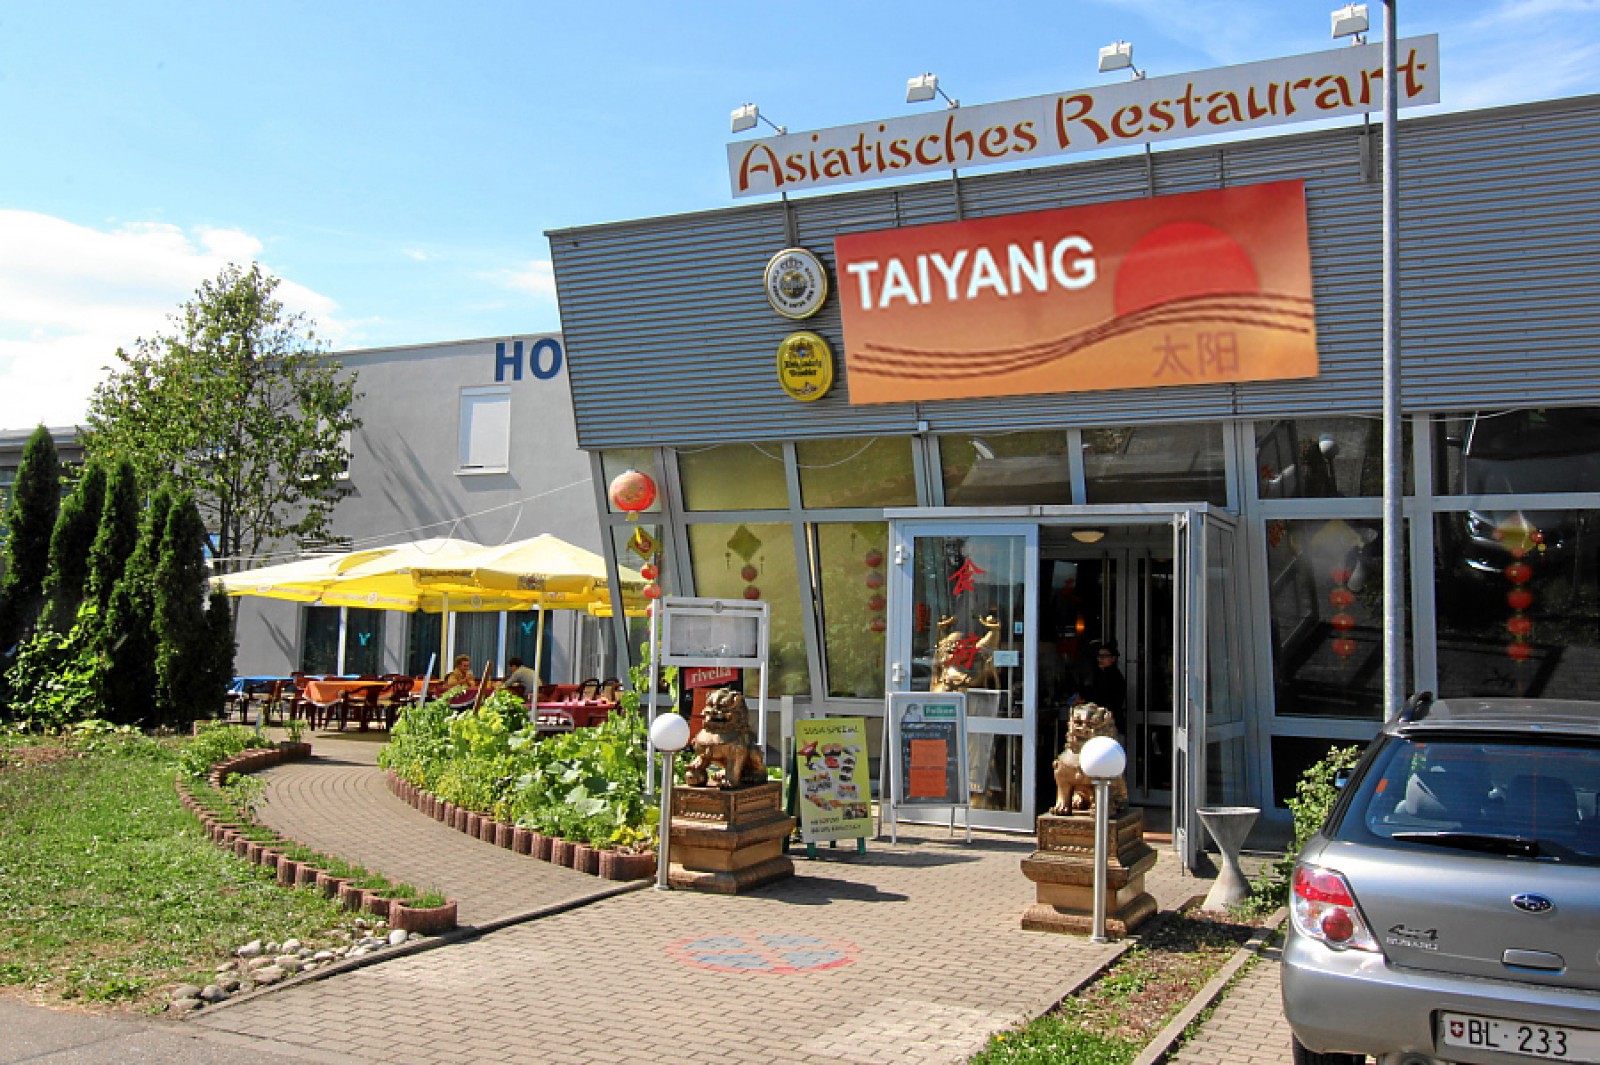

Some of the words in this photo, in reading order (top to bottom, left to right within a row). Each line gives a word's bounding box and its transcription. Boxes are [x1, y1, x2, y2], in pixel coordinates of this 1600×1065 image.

[738, 115, 1037, 193] Asiatisches
[1055, 49, 1427, 144] Restaurant
[847, 236, 1097, 310] TAIYANG
[494, 338, 562, 382] HO
[1152, 332, 1239, 377] 太阳
[691, 667, 732, 684] rivella
[1517, 1026, 1567, 1056] 233
